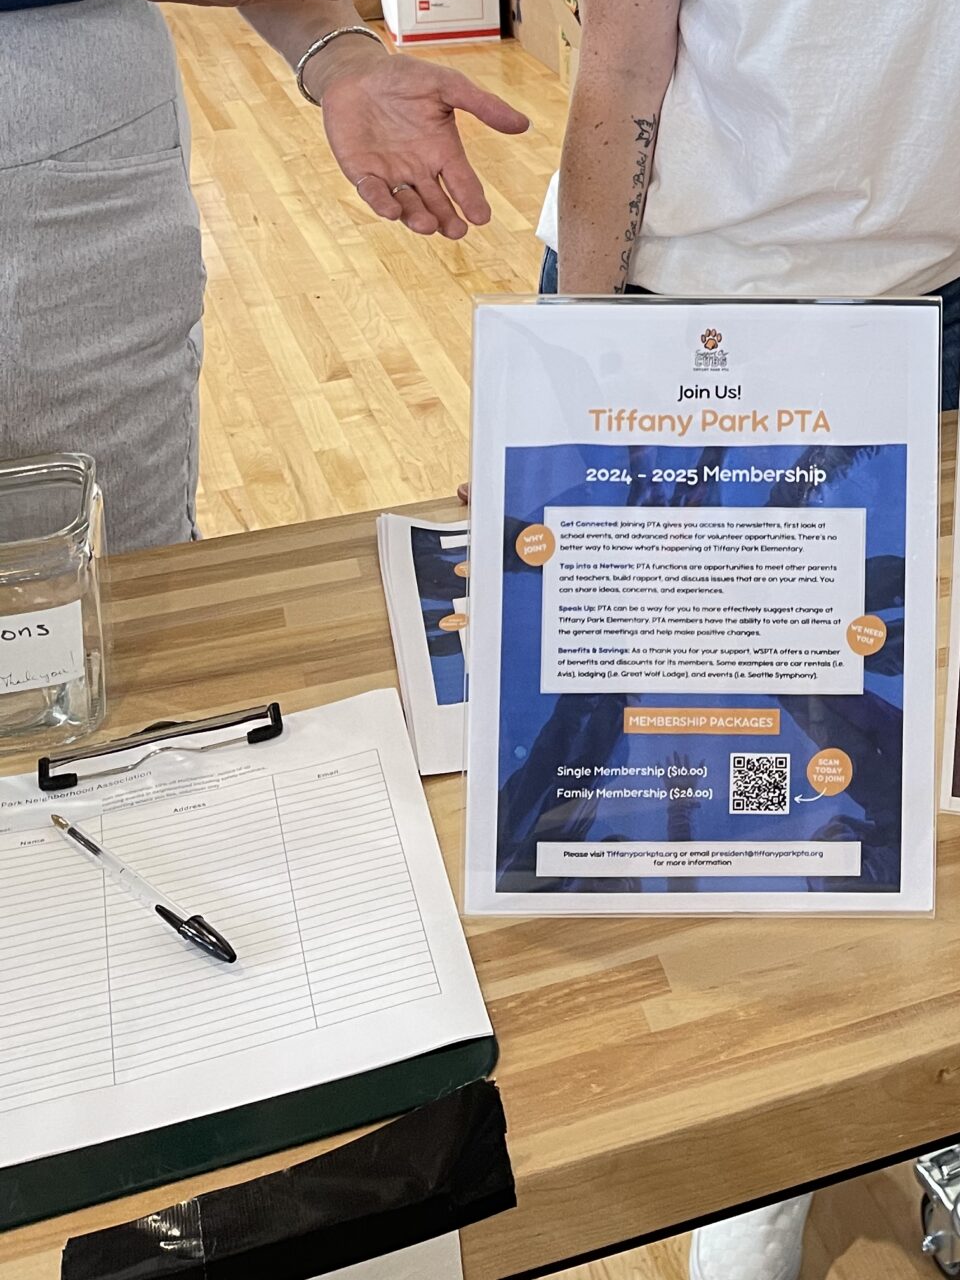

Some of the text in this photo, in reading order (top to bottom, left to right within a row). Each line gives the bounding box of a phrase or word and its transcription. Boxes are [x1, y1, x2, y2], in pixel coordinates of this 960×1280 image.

[678, 384, 742, 402] Join Us!
[588, 408, 830, 436] Tiffany Park PTA
[586, 468, 632, 485] 2024
[652, 468, 698, 486] 2025
[704, 465, 826, 486] Membership
[620, 521, 646, 529] Joining
[524, 534, 544, 542] WHY
[864, 627, 884, 638] NEED
[628, 716, 774, 728] MEMBERSHIP PACKAGES
[818, 758, 840, 766] SCAN
[556, 766, 708, 778] Single Membership ($16.00)
[815, 766, 842, 774] TODAY
[812, 774, 824, 782] TO
[1, 800, 22, 808] Park
[96, 771, 152, 790] Association
[556, 788, 714, 800] Family Membership ($28.00)
[174, 802, 206, 813] Address
[20, 838, 45, 846] Name
